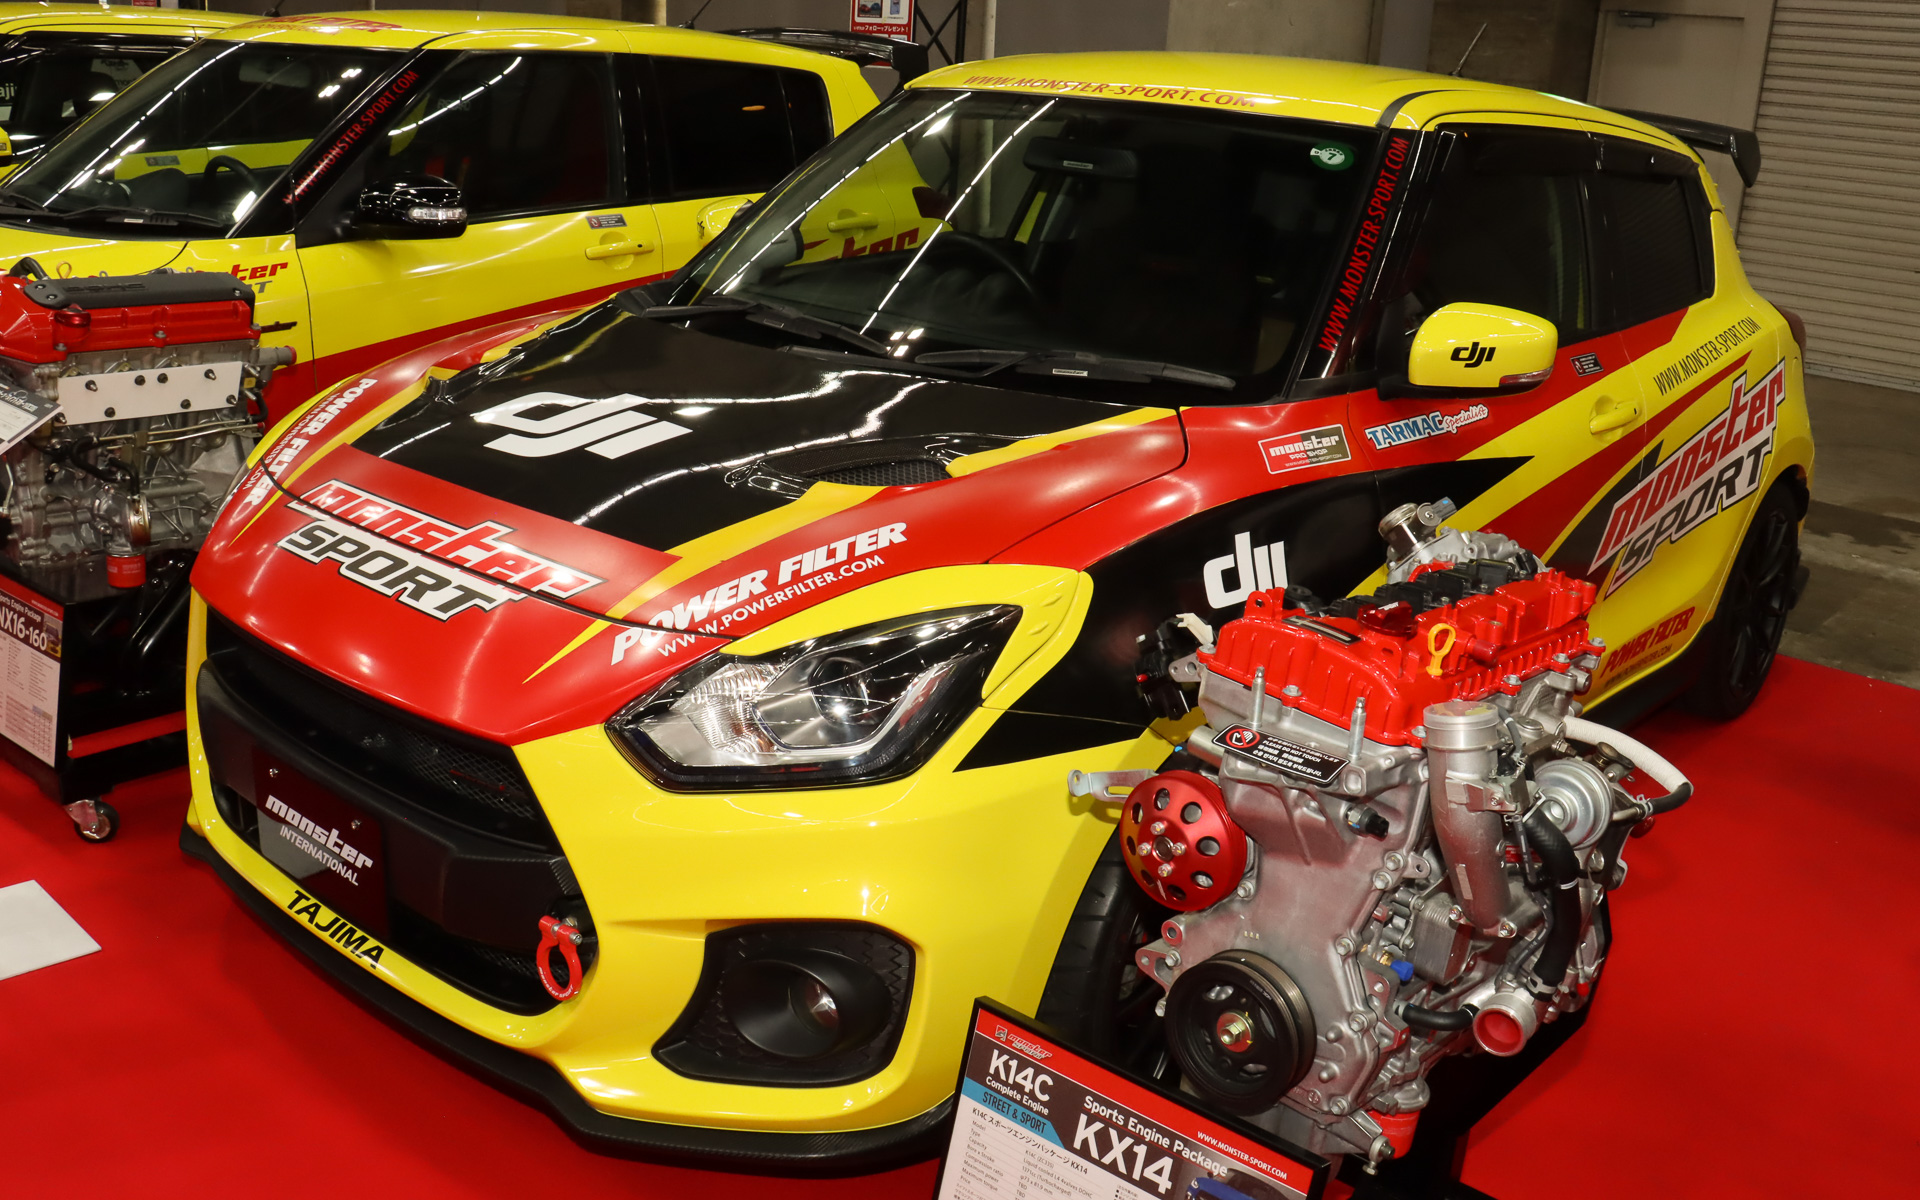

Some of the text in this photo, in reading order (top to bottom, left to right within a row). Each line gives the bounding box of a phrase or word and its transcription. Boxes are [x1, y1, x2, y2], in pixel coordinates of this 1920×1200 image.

[963, 75, 1257, 108] WWW.MONSTER-SPORT.COM
[1318, 136, 1410, 351] WWW.MONSTER-SPORT.COM
[1653, 316, 1762, 396] WWW.MONSTER-SPORT.COM
[243, 377, 378, 506] POWER FILTER
[1268, 435, 1339, 457] monster
[1367, 413, 1444, 447] TARMAC
[1289, 452, 1308, 460] PRO
[1592, 366, 1784, 567] monster
[1617, 436, 1771, 574] SPORT
[285, 523, 497, 615] SPORT
[610, 522, 908, 666] POWER FILTER
[657, 554, 885, 658] WWW.POWERFILTER.COM
[1262, 740, 1281, 751] PLEASE
[1290, 748, 1303, 757] NOT
[1302, 752, 1322, 763] TOUCH
[265, 794, 374, 869] monster
[280, 825, 359, 886] INTERNATIONAL
[287, 889, 385, 970] TAJIMA
[985, 1076, 1050, 1116] Complete Engine
[989, 1049, 1054, 1102] K14C
[970, 1128, 981, 1138] Type
[972, 1107, 987, 1121] K14C
[972, 1120, 987, 1132] Model
[982, 1091, 1047, 1134] STREET & SPORT
[968, 1136, 987, 1151] Capacity
[981, 1150, 995, 1163] Stroke
[988, 1115, 1070, 1164] スポーツエンジンパッケージ
[1073, 1113, 1174, 1195] KX14
[1083, 1095, 1228, 1179] Sports Engine Package
[1197, 1130, 1287, 1180] WWW.MONSTER-SPORT.COM
[960, 1175, 971, 1185] Price
[962, 1167, 983, 1183] Maximum
[983, 1179, 998, 1192] torque
[964, 1159, 999, 1183] Maximum power
[965, 1151, 993, 1170] Compression
[1070, 1160, 1088, 1175] KX14
